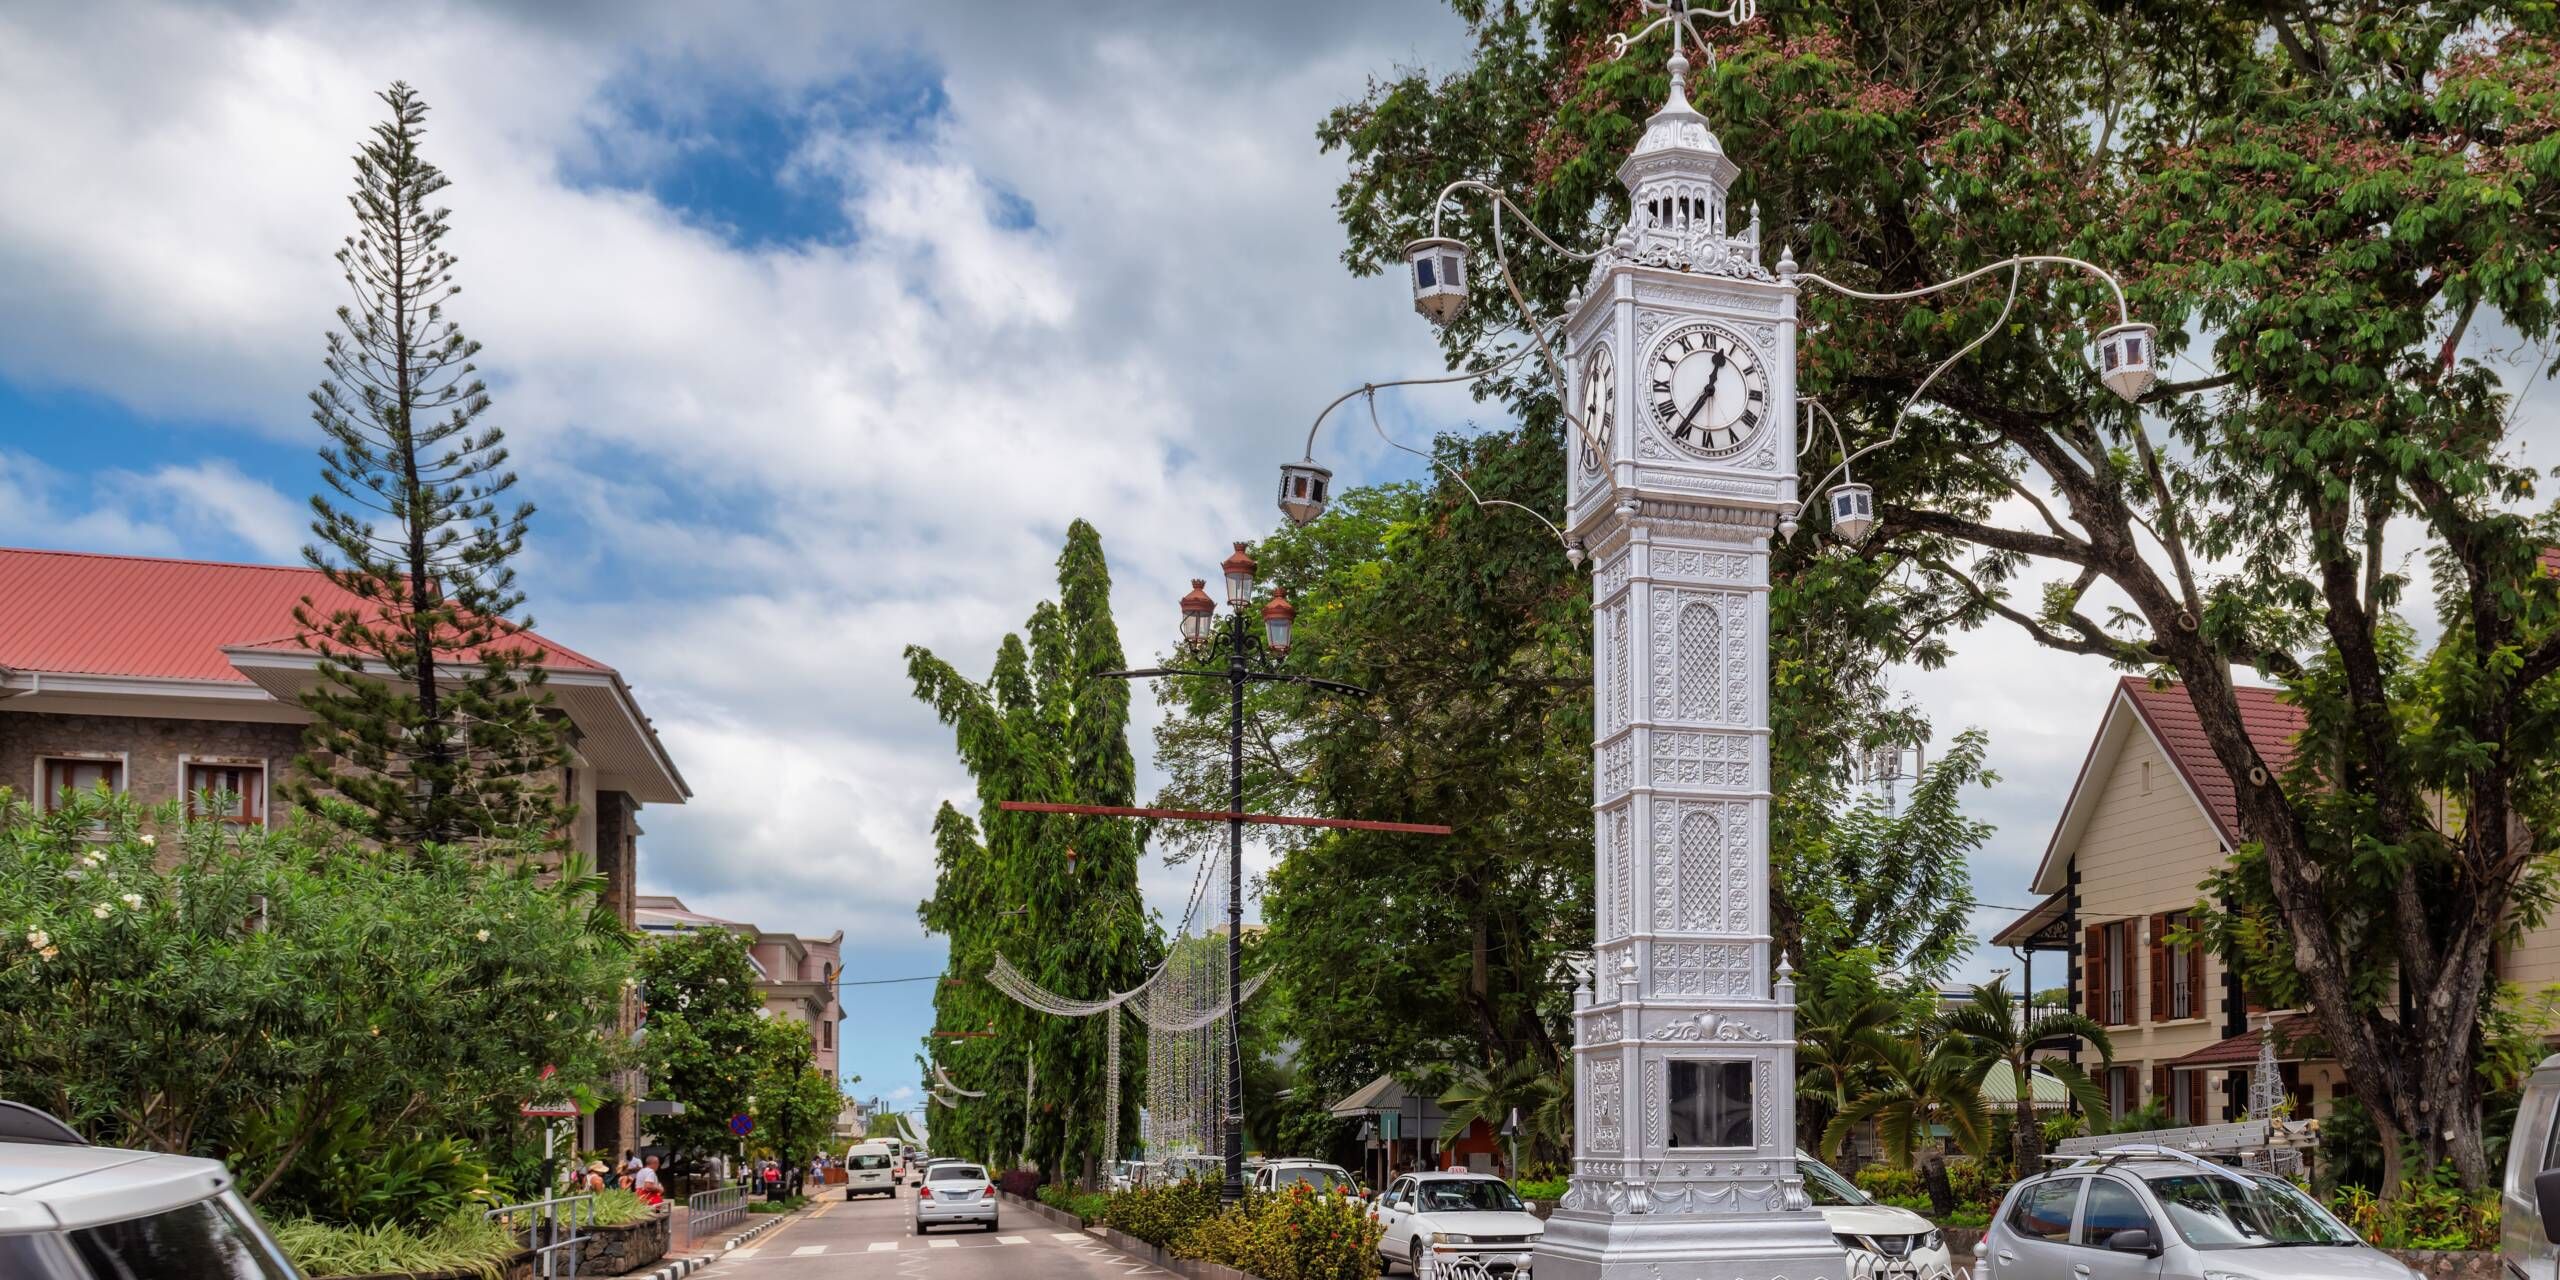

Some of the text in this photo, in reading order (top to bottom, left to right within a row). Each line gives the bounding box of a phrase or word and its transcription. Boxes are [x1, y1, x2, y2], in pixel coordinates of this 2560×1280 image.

[1677, 335, 1694, 354] XI
[1702, 333, 1717, 350] XII
[1728, 343, 1737, 357] I
[1660, 352, 1677, 371] X
[1743, 365, 1755, 377] II
[1653, 379, 1671, 393] IX
[1749, 389, 1763, 402] III
[1658, 399, 1678, 422] VIII
[1702, 430, 1714, 449] VI
[1728, 427, 1740, 445] V
